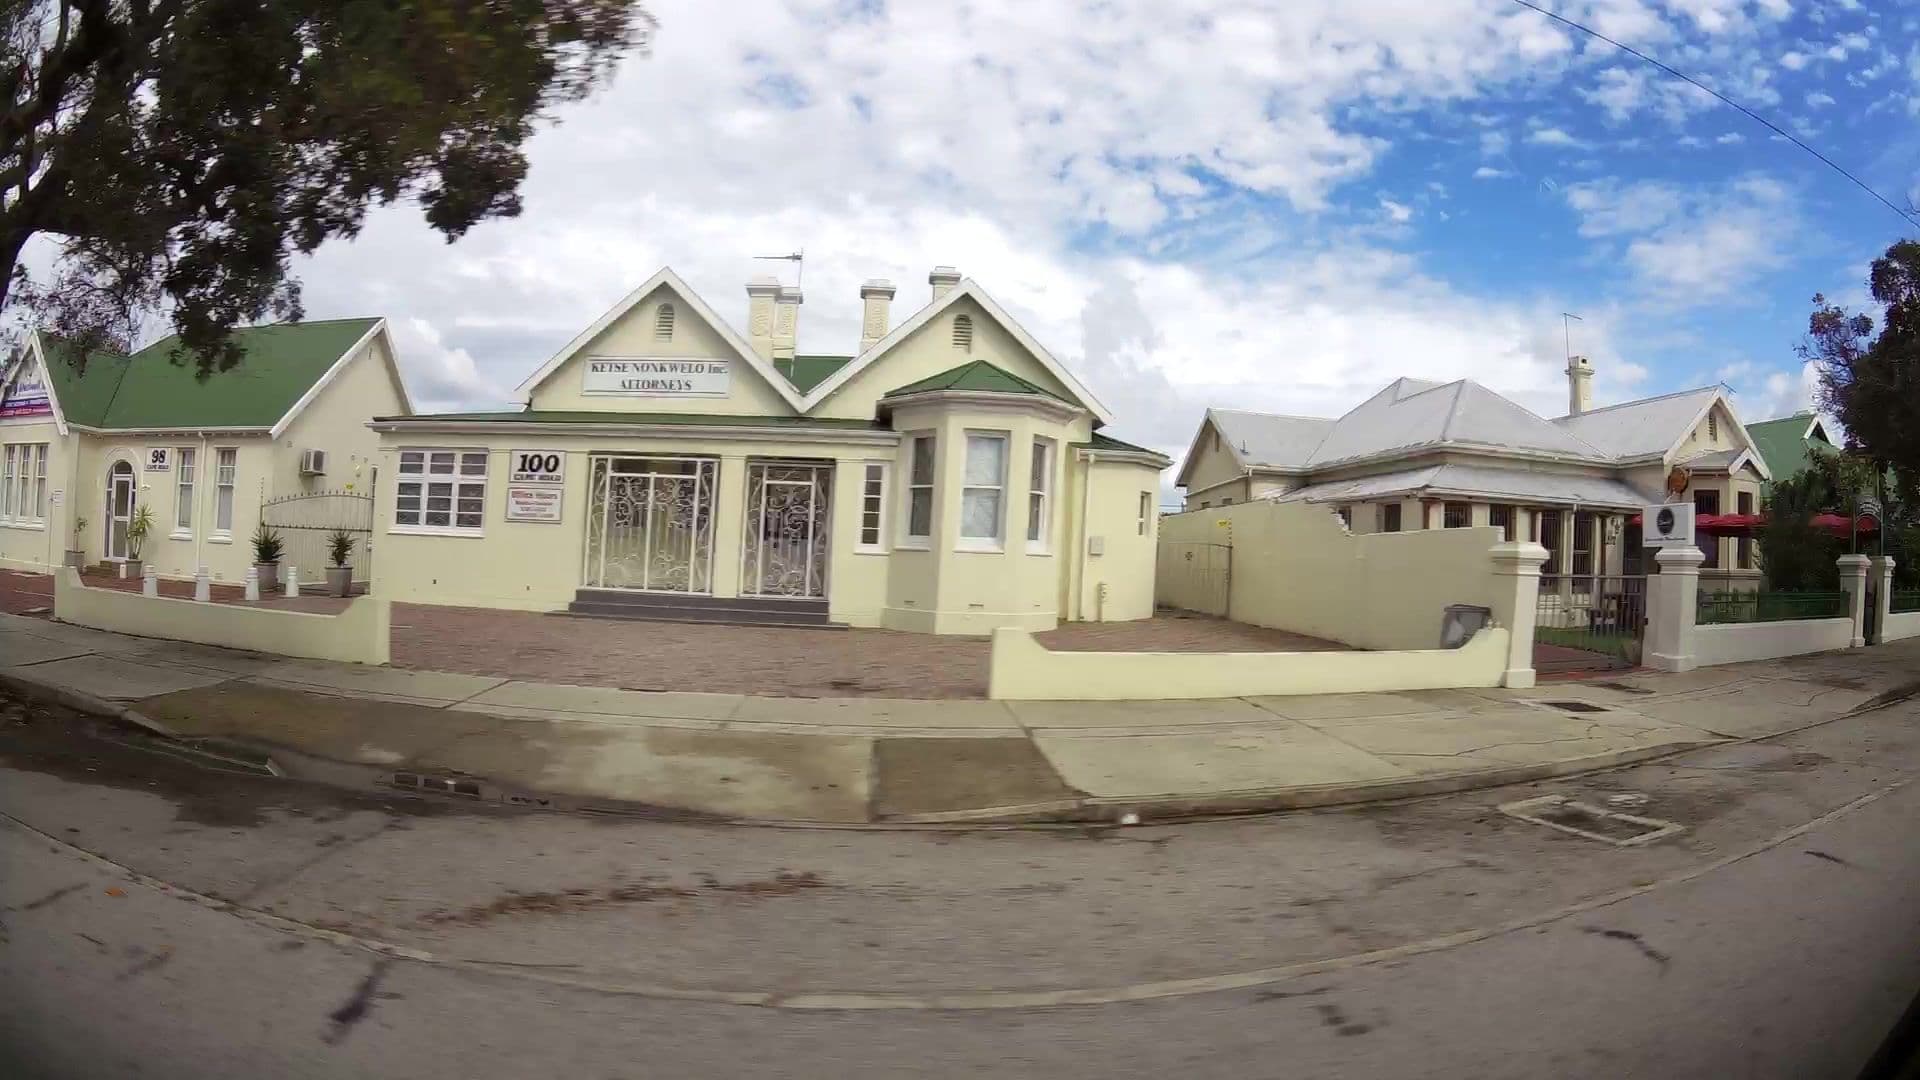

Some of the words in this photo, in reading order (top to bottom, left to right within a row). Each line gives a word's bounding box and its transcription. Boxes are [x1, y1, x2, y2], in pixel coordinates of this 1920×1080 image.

[632, 362, 704, 374] NONKWELO
[620, 379, 692, 390] ATTORNEYS
[152, 449, 166, 463] 98
[517, 454, 560, 473] 100
